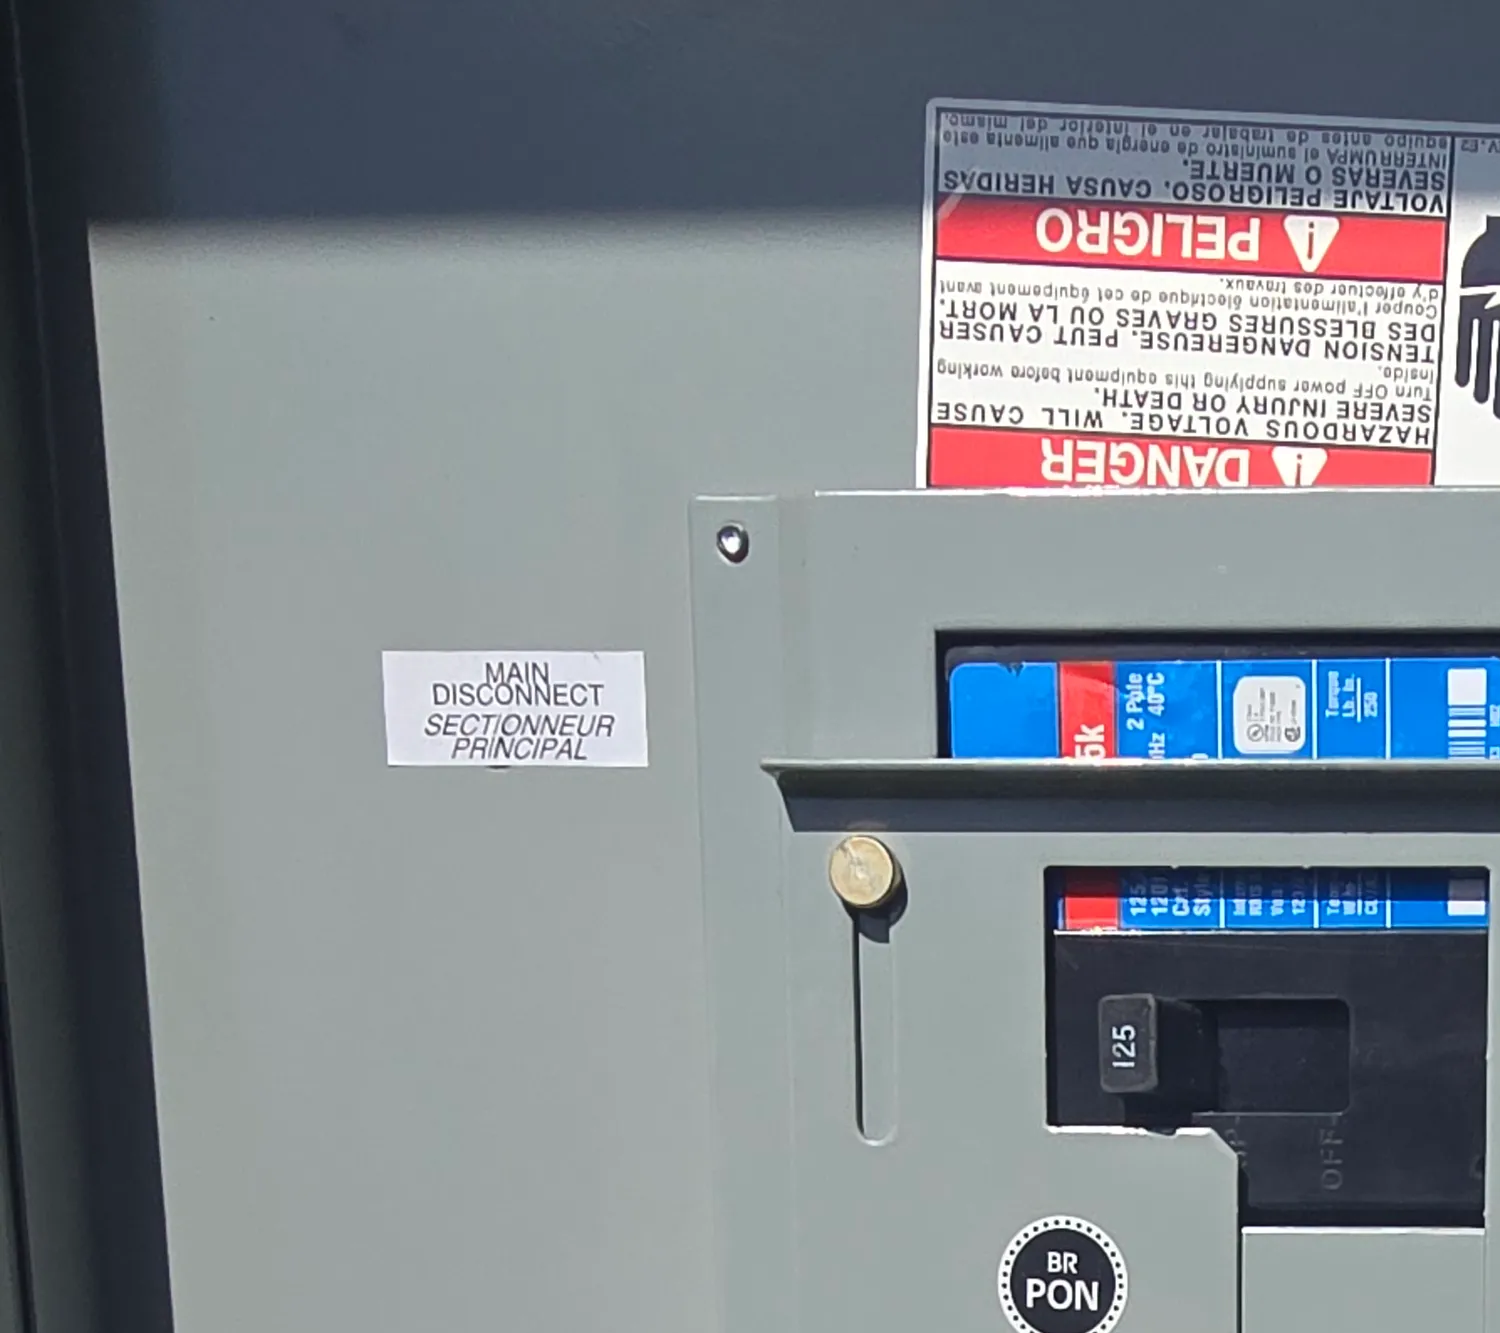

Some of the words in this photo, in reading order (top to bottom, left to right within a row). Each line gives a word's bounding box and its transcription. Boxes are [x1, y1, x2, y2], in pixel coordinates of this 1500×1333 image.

[942, 169, 1054, 195] HERIDAS
[1181, 157, 1295, 185] MUERTE.
[1303, 164, 1322, 186] O
[1330, 165, 1446, 192] SEVERAS
[1064, 175, 1151, 199] CAUSA
[1163, 179, 1321, 208] PELIGROSO.
[1332, 187, 1444, 214] VOLTAJE
[1034, 206, 1260, 262] PELIGRO
[938, 297, 1017, 322] MORT.
[1026, 302, 1058, 324] LA
[1069, 304, 1105, 326] OU
[1114, 307, 1217, 332] GRAVES
[938, 319, 1042, 345] CAUSER
[1052, 325, 1119, 348] PEUT
[1227, 312, 1376, 340] BLESSURES
[1386, 320, 1435, 343] DES
[1130, 328, 1311, 358] DANGEREUSE.
[1323, 338, 1435, 364] TENSION
[930, 357, 1003, 381] working
[1163, 372, 1196, 390] this
[1202, 370, 1286, 395] supplying
[1352, 381, 1388, 400] OFF
[1392, 379, 1433, 402] Turn
[1092, 386, 1182, 411] DEATH.
[1191, 391, 1225, 414] OR
[1235, 394, 1326, 419] INJURY
[934, 401, 1024, 426] CAUSE
[1039, 406, 1104, 429] WILL
[1120, 410, 1249, 436] VOLTAGE.
[1335, 399, 1432, 424] SEVERE
[1264, 418, 1430, 446] HAZARDOUS
[1039, 437, 1251, 490] DANGER
[485, 662, 549, 684] MAIN
[432, 683, 604, 706] DISCONNECT
[1126, 673, 1147, 713] Pole
[424, 714, 615, 737] SECTIONNEUR
[451, 737, 588, 760] PRINCIPAL
[1112, 1023, 1135, 1069] 125
[1047, 1251, 1078, 1275] BR
[1026, 1278, 1100, 1312] PON
